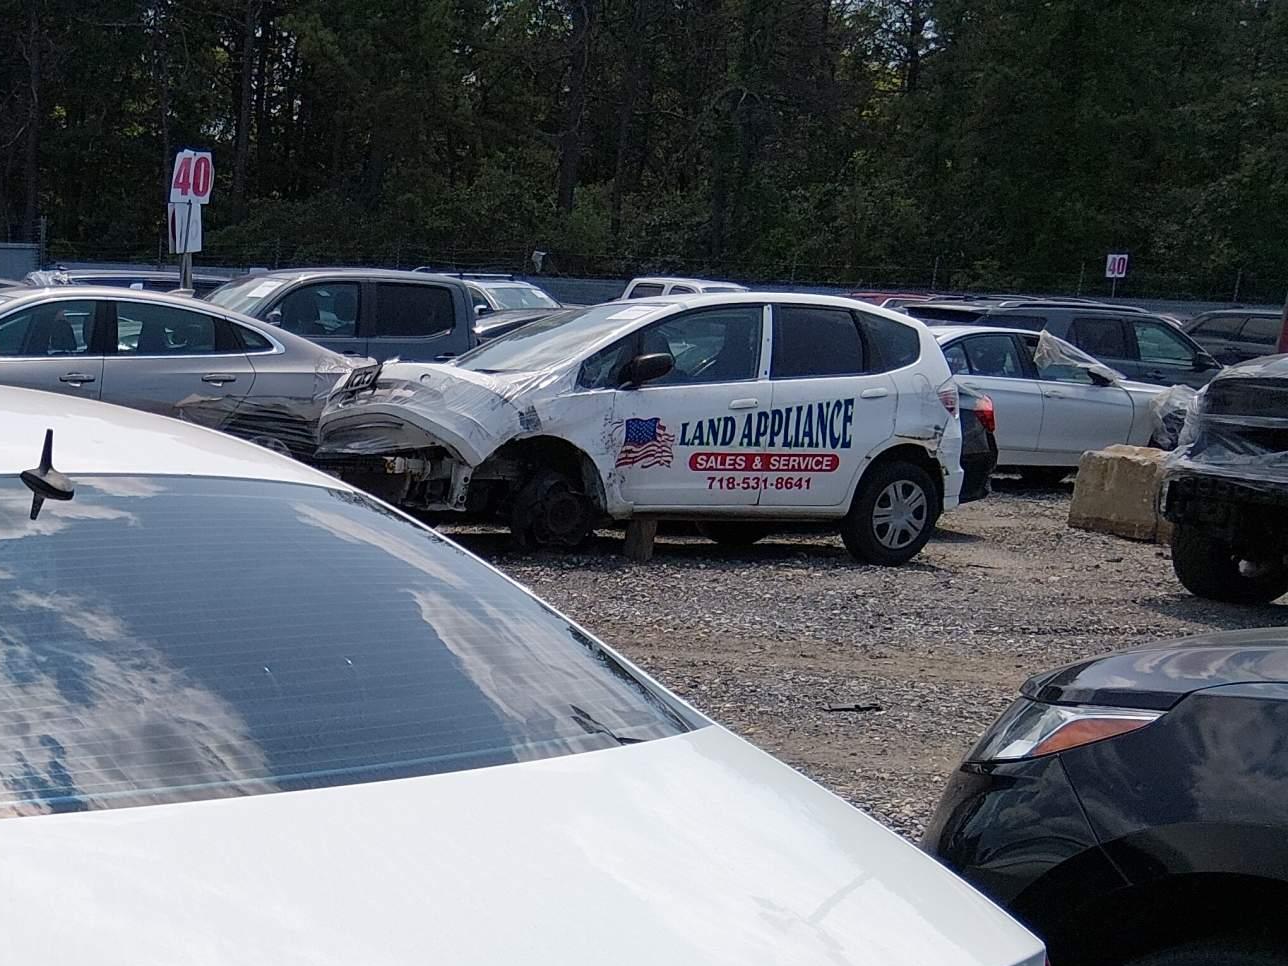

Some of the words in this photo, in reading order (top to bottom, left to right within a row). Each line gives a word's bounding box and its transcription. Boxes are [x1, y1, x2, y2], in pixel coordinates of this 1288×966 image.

[173, 156, 210, 198] 40
[1107, 256, 1126, 275] 40
[679, 415, 737, 447] LAND
[740, 397, 856, 450] APPLIANCE
[696, 455, 746, 470] SALES
[751, 456, 762, 469] &
[769, 456, 833, 470] SERVICE
[706, 476, 812, 491] 718-531-8641
